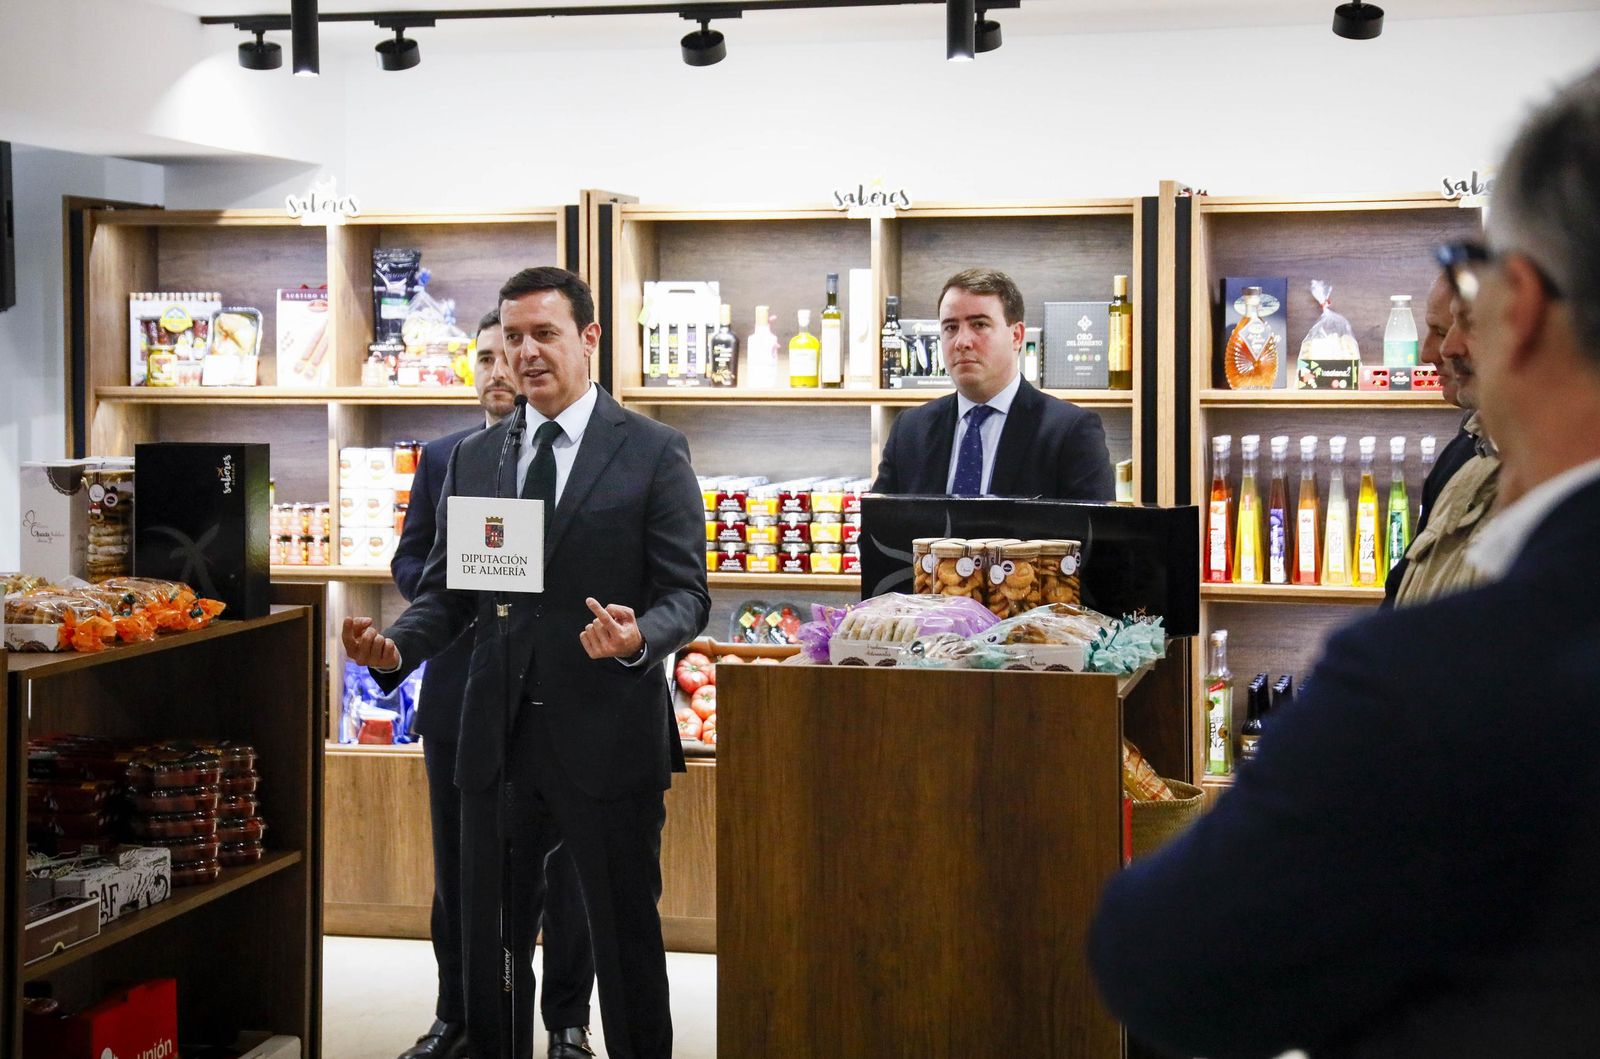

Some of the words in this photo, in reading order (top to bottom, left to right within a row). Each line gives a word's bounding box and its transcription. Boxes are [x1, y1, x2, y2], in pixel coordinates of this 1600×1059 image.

[834, 184, 910, 207] sabores
[1076, 333, 1093, 341] ORO
[220, 454, 232, 494] sabores
[461, 553, 528, 565] DIPUTACIÓN
[462, 565, 477, 574] DE
[479, 565, 527, 577] ALMERÍA
